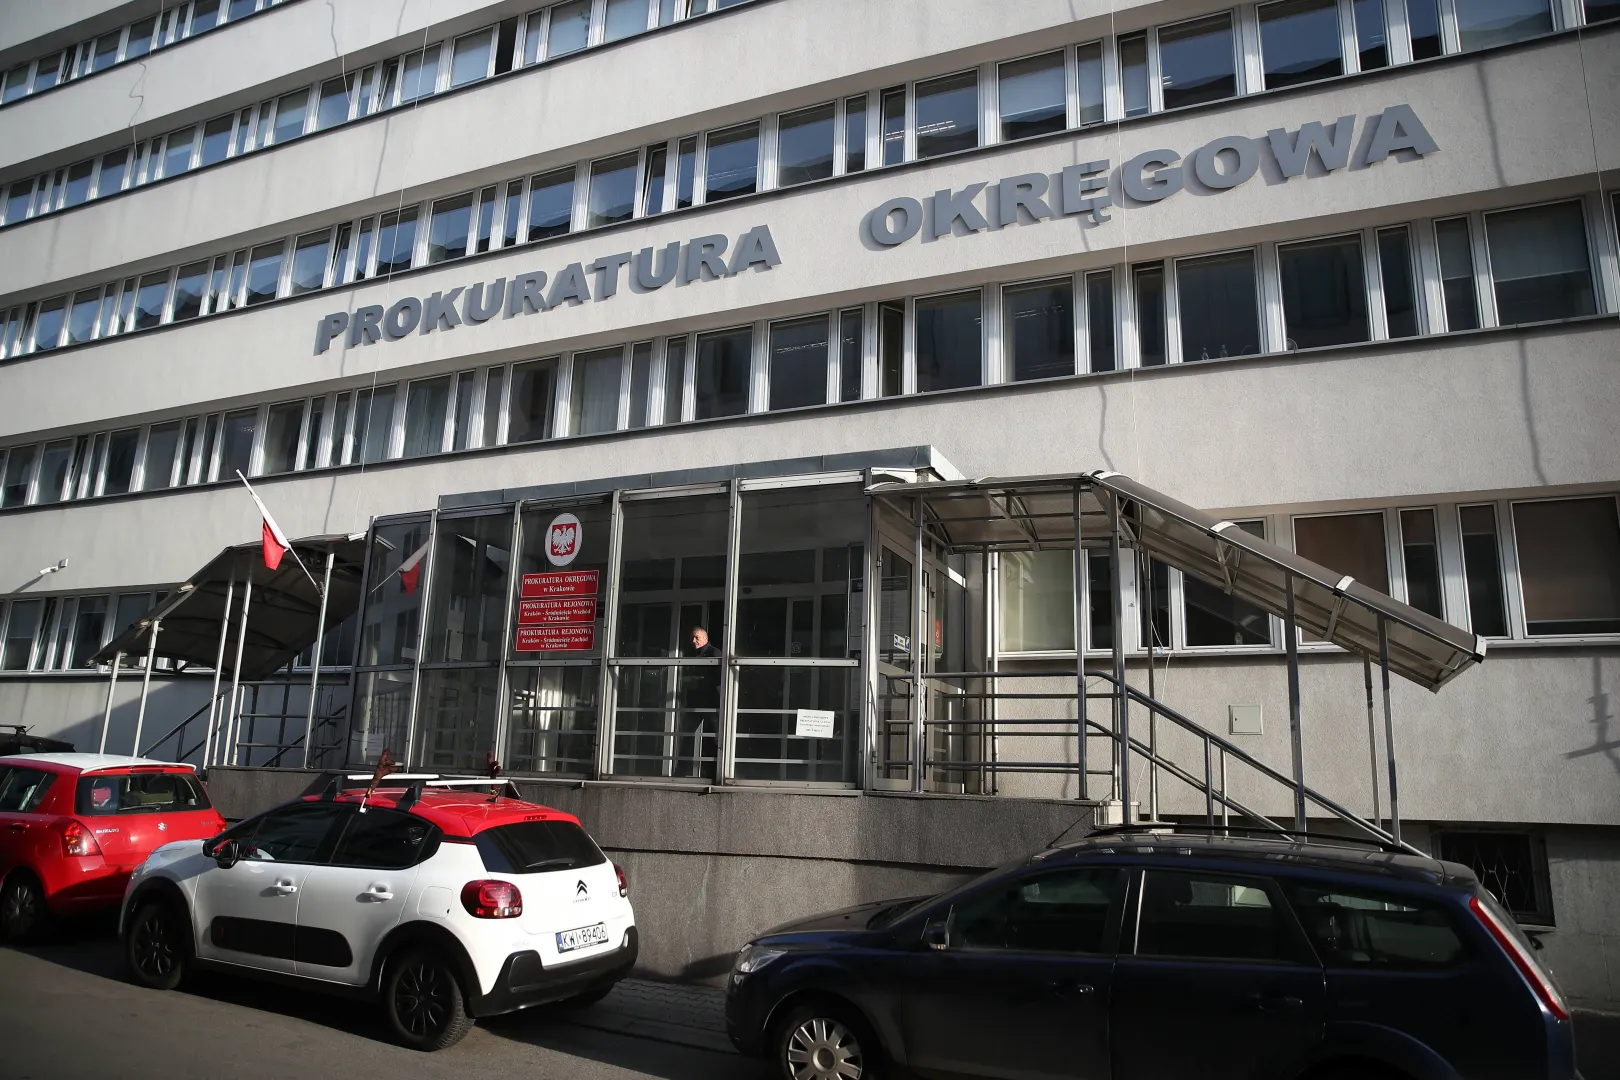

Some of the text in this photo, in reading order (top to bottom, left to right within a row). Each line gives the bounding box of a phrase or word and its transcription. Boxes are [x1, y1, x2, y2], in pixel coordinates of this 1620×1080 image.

[317, 103, 1441, 354] PROKURATURA OKRĘGOWA
[524, 575, 596, 585] PROKURATURA OKRĘGOWA
[562, 930, 580, 948] KWI
[581, 925, 606, 943] 89406
